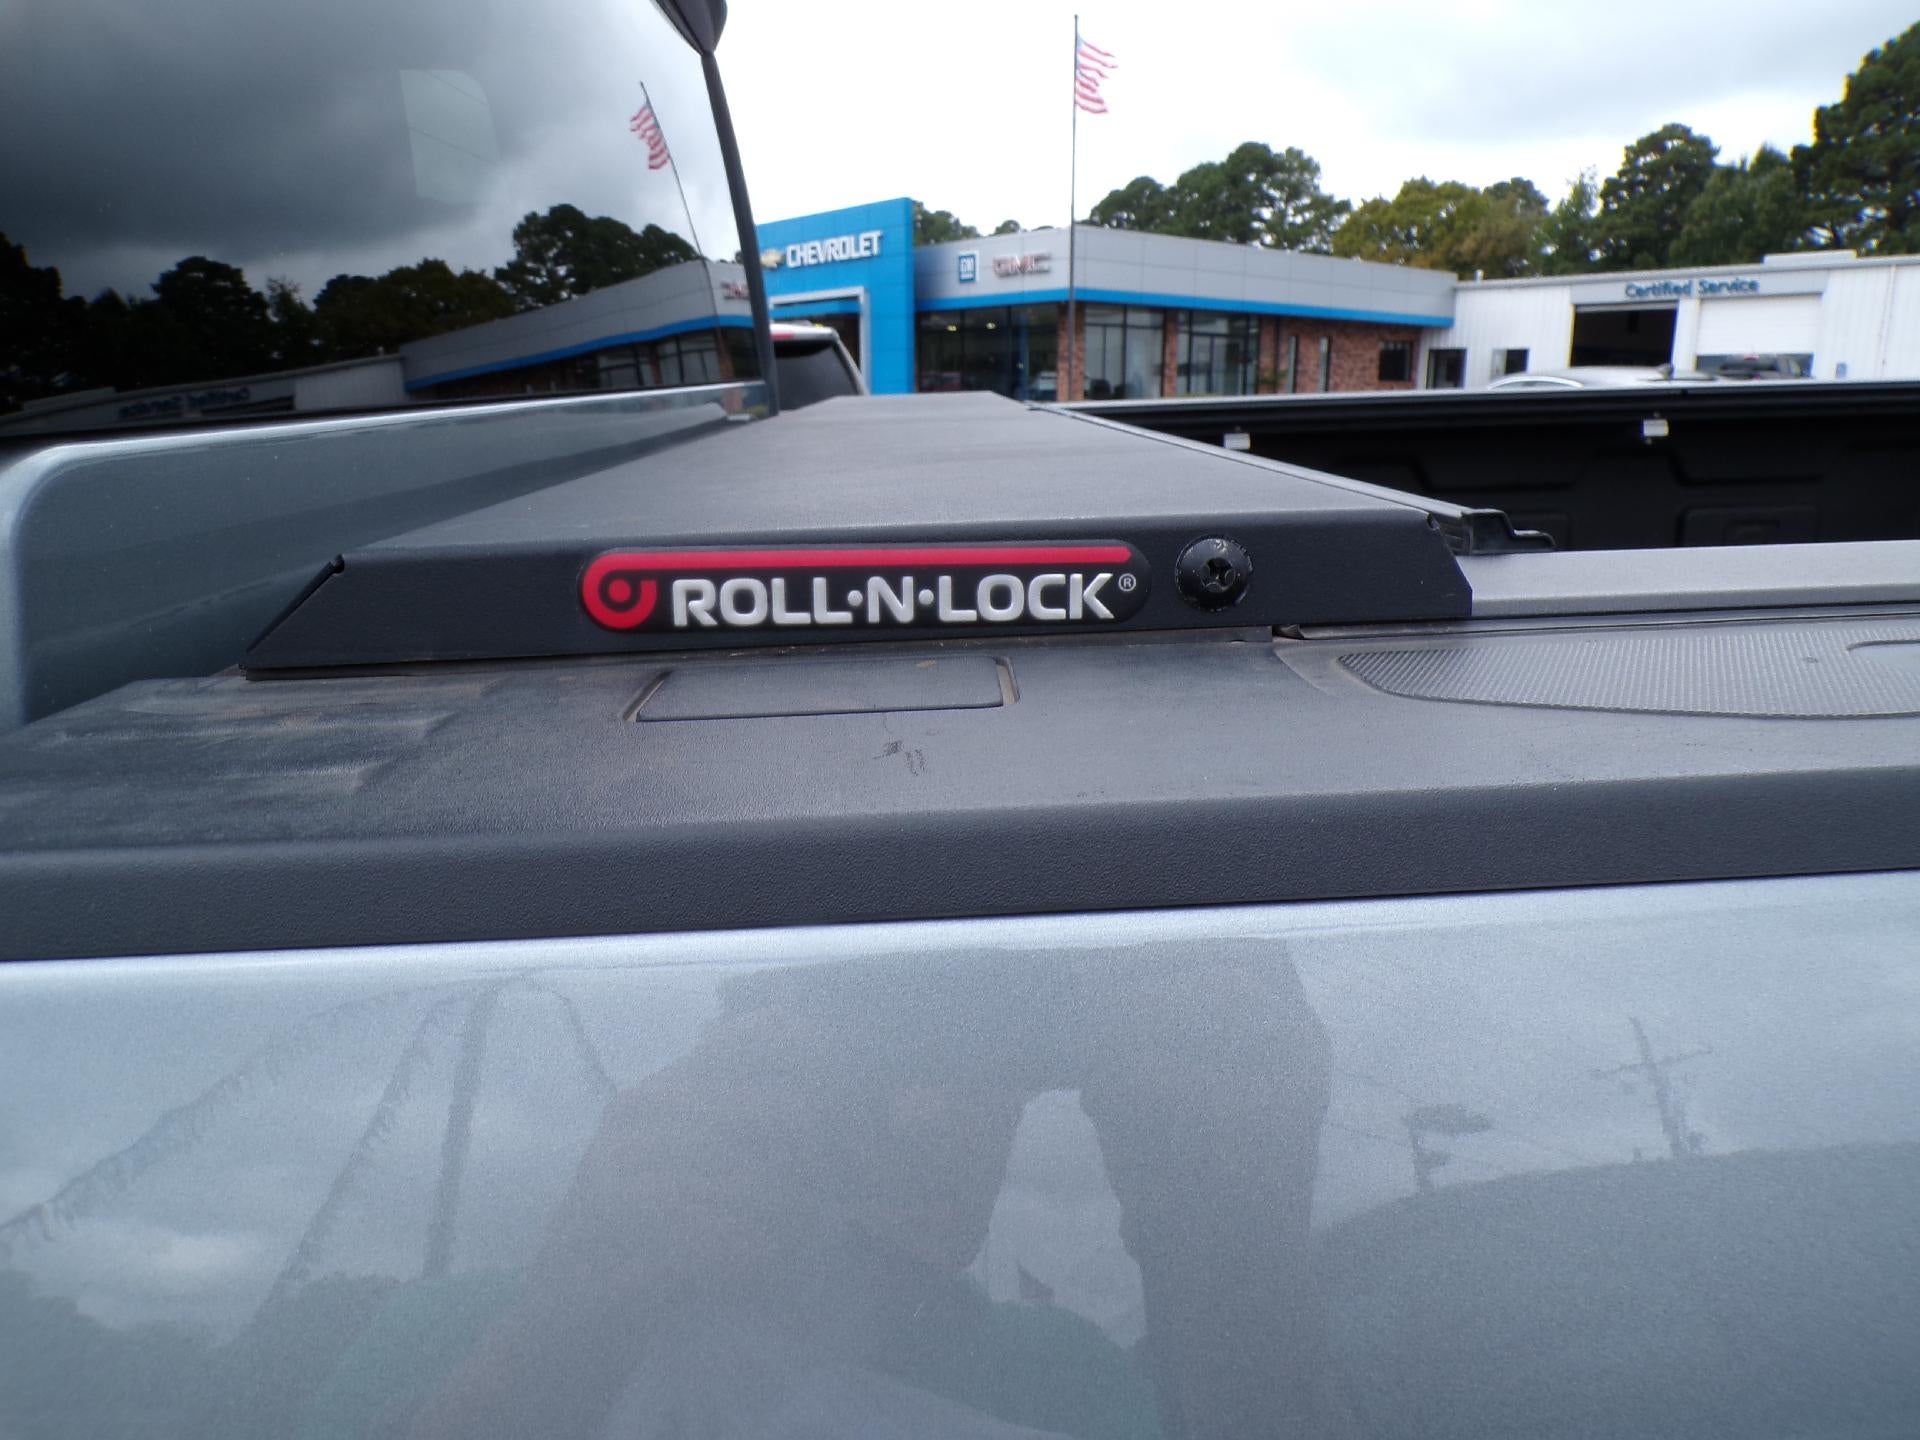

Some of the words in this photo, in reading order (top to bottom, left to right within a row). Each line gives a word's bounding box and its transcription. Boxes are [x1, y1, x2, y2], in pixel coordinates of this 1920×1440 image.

[786, 230, 882, 268] CHEVROLET
[992, 254, 1051, 277] GMC
[1625, 280, 1692, 298] Certified
[1698, 277, 1759, 295] Service
